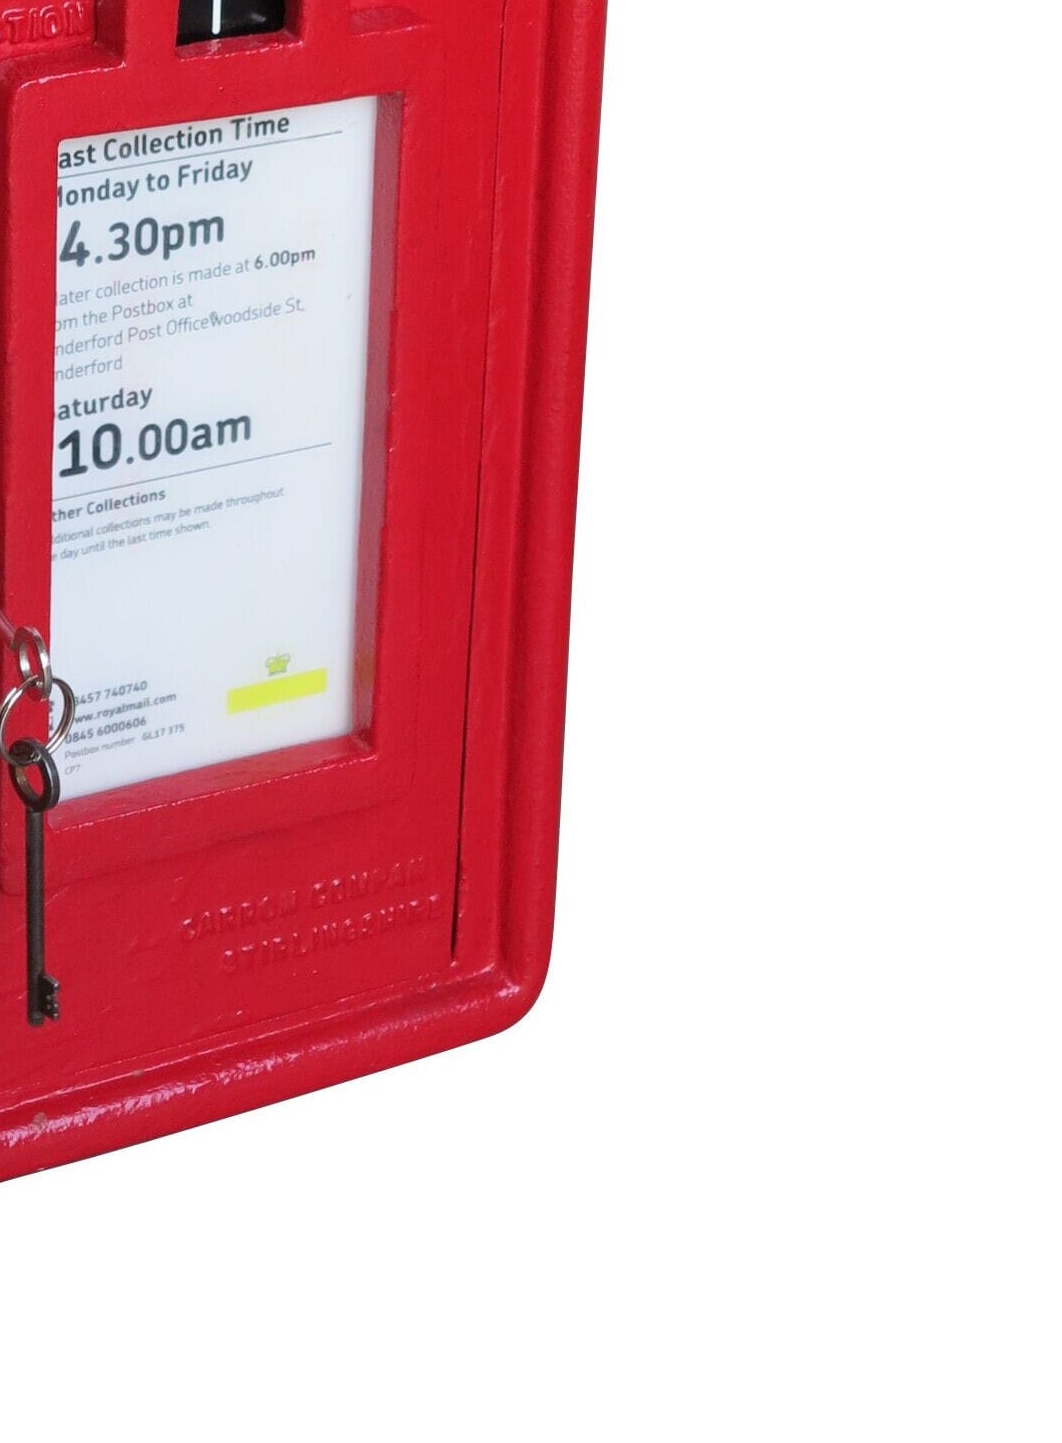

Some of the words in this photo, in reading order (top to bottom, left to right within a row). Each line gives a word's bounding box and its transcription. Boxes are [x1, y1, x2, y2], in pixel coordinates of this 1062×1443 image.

[57, 143, 97, 169] ast
[103, 125, 223, 162] Collection
[230, 116, 290, 141] Time
[145, 172, 170, 192] to
[177, 158, 254, 188] Friday
[58, 214, 225, 268] 4.30pm
[56, 288, 92, 306] ater
[95, 275, 169, 299] collection
[171, 270, 184, 286] is
[188, 262, 232, 282] made
[234, 258, 251, 275] at
[254, 248, 316, 270] 6.00pm
[82, 310, 108, 327] the
[112, 299, 175, 321] Postbox
[177, 294, 194, 310] at
[55, 329, 124, 357] nderford
[127, 323, 163, 343] Post
[55, 354, 124, 382] nderford
[57, 386, 154, 421] aturday
[57, 413, 253, 479] 10.00am
[52, 505, 83, 523] ther
[86, 488, 167, 516] Collections
[53, 525, 95, 545] ditional
[96, 515, 152, 537] collections
[154, 510, 178, 524] may
[179, 506, 193, 519] be
[194, 499, 224, 515] made
[225, 487, 285, 509] throughout
[60, 547, 80, 561] day
[81, 539, 106, 556] until
[108, 536, 126, 550] the
[127, 532, 148, 546] last
[149, 528, 173, 542] time
[74, 690, 102, 708] 8457
[105, 679, 149, 700] 740740
[74, 693, 178, 725] ww.royalmail.com
[65, 728, 94, 744] 0845
[97, 716, 148, 738] 6000606
[64, 745, 100, 761] Postbox
[101, 736, 136, 751] number
